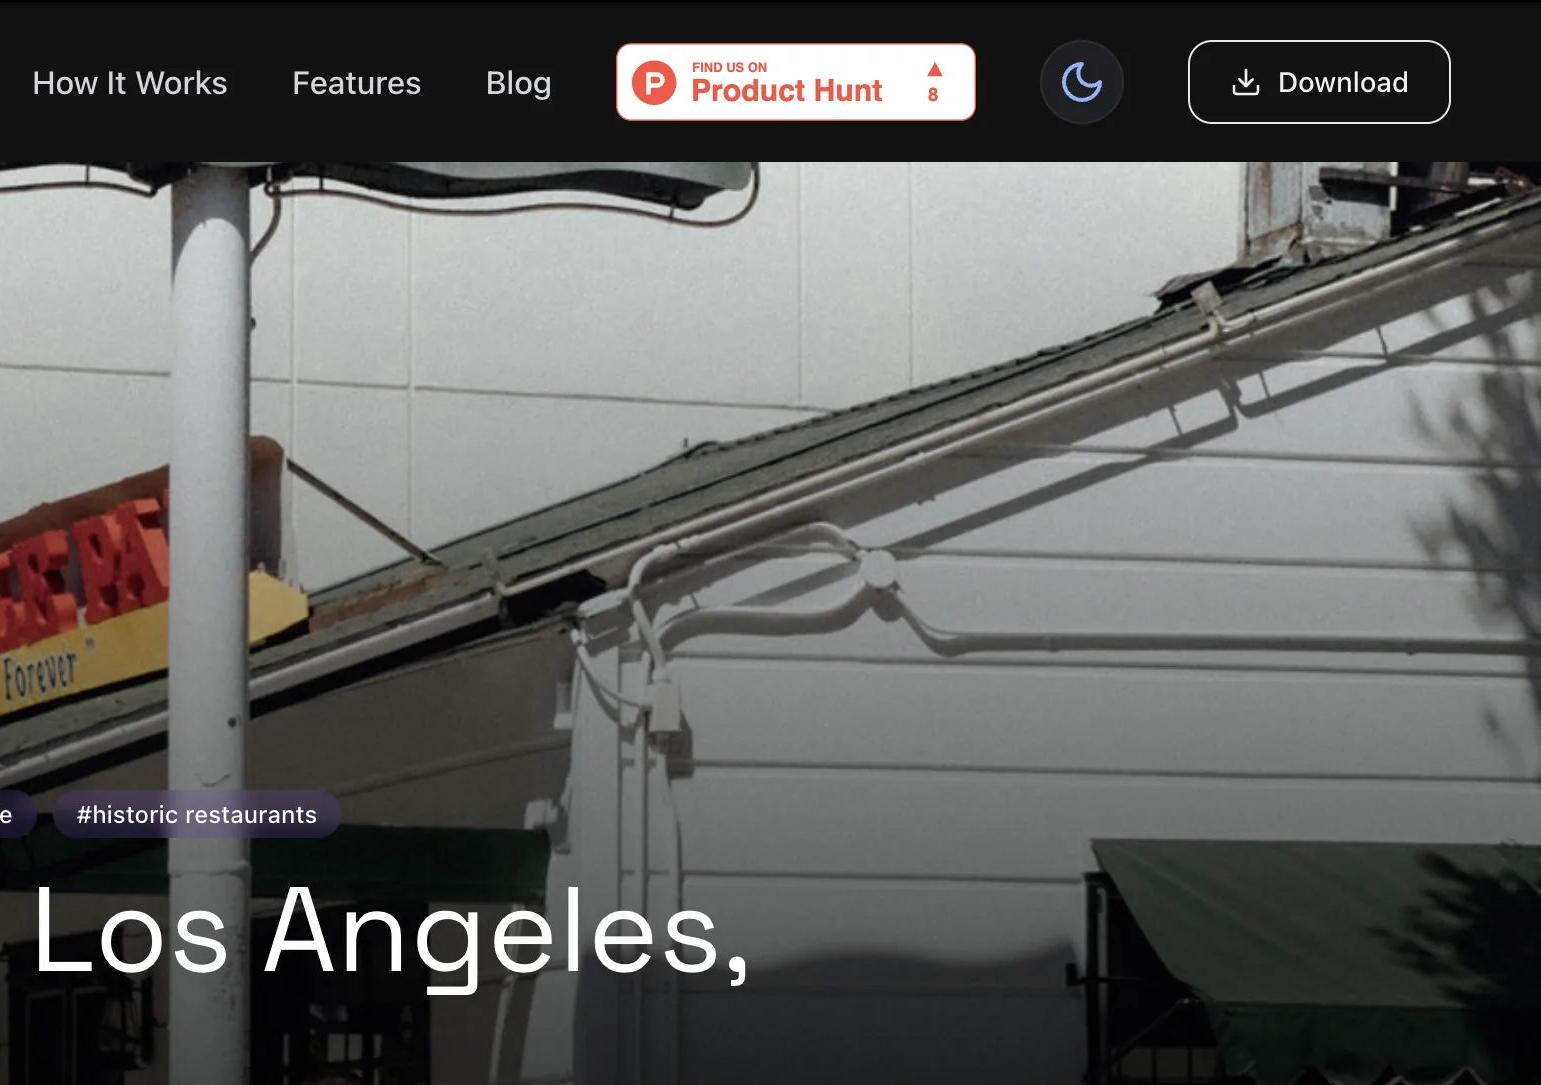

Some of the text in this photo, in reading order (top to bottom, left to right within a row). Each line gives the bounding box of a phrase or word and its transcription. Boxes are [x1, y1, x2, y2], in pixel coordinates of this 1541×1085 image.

[692, 61, 767, 73] FIND US ON
[34, 70, 228, 95] How It Works
[294, 70, 421, 95] Features
[487, 70, 551, 101] Blog
[692, 78, 883, 102] Product Hunt
[1278, 70, 1408, 93] Download
[927, 87, 939, 102] 8
[72, 488, 169, 625] PA
